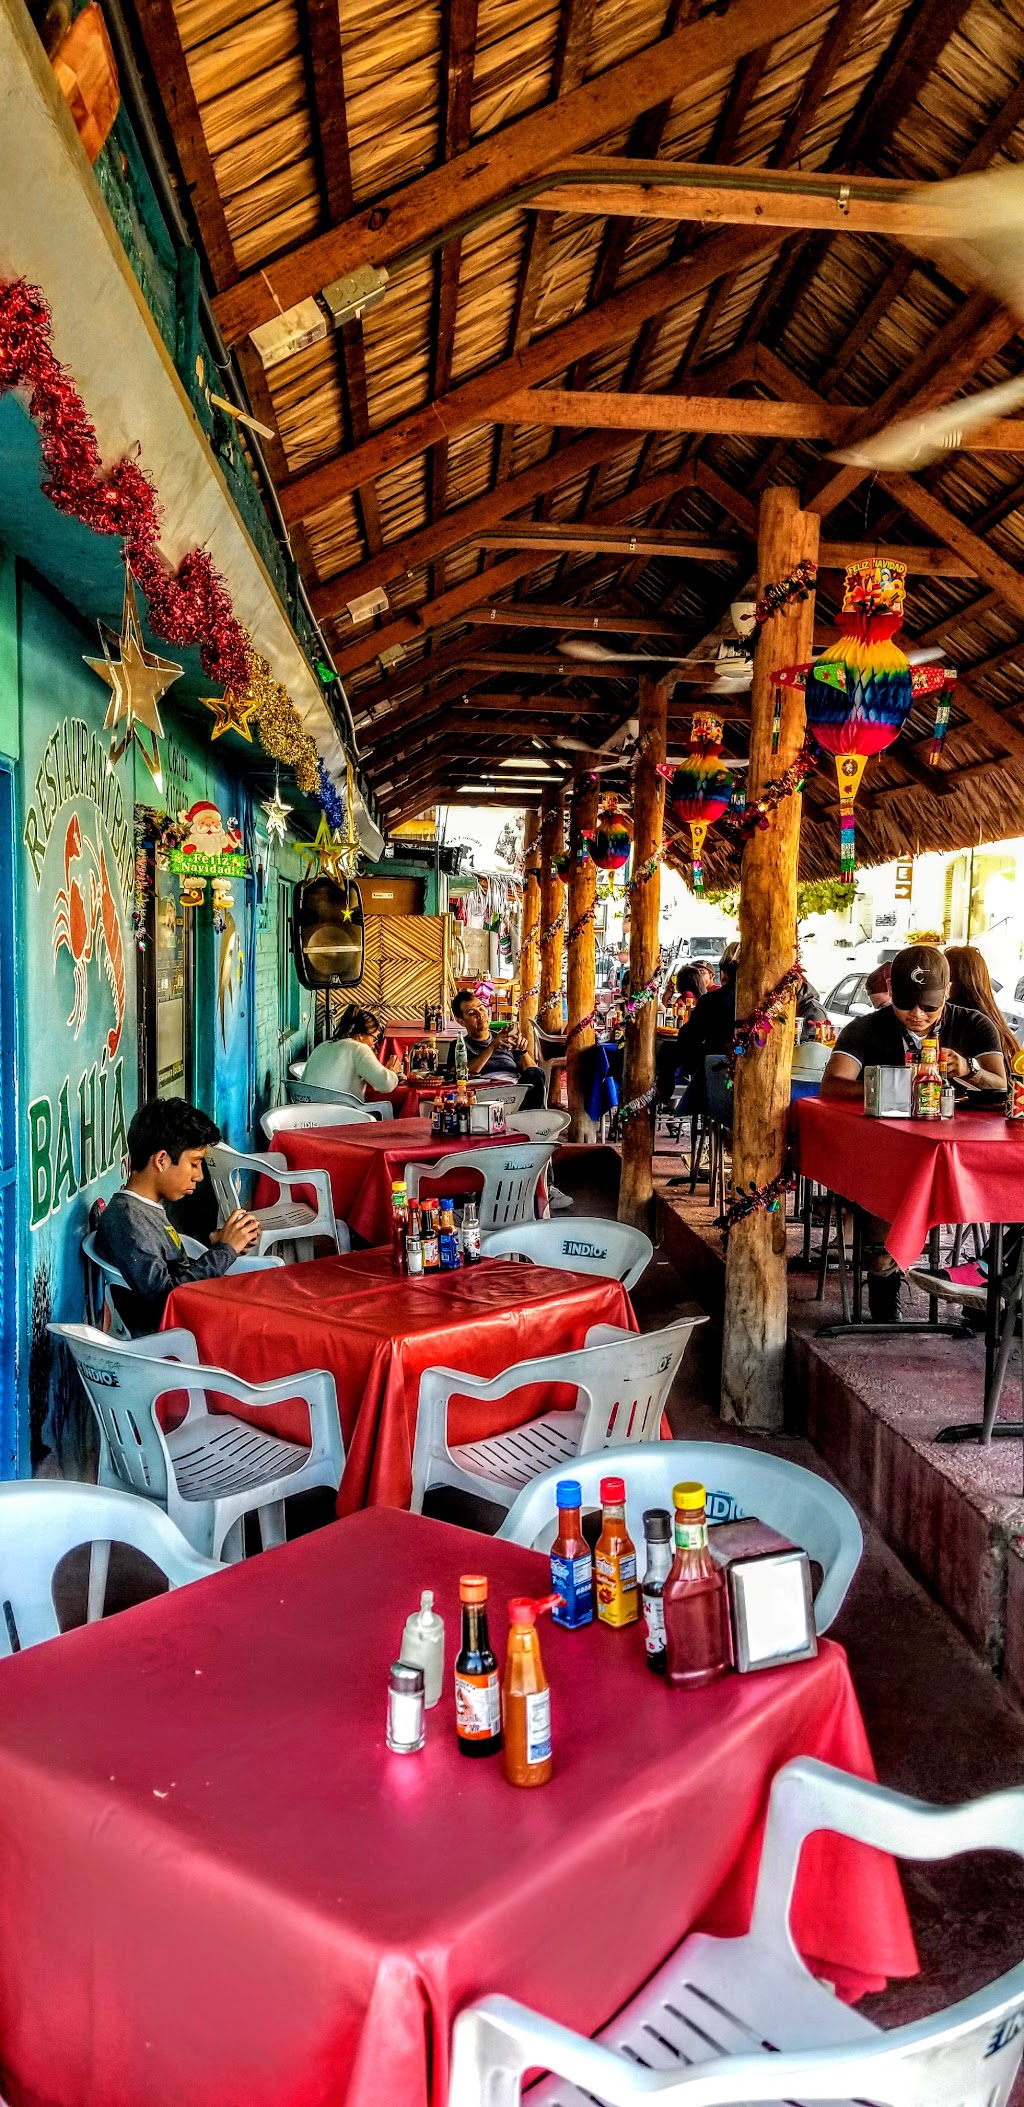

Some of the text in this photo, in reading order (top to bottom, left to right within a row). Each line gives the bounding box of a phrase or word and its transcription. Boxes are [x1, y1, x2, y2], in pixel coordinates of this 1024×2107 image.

[848, 559, 905, 575] FELIZ NAVIDAD
[194, 853, 229, 866] Feliz
[567, 1242, 603, 1258] INDIO
